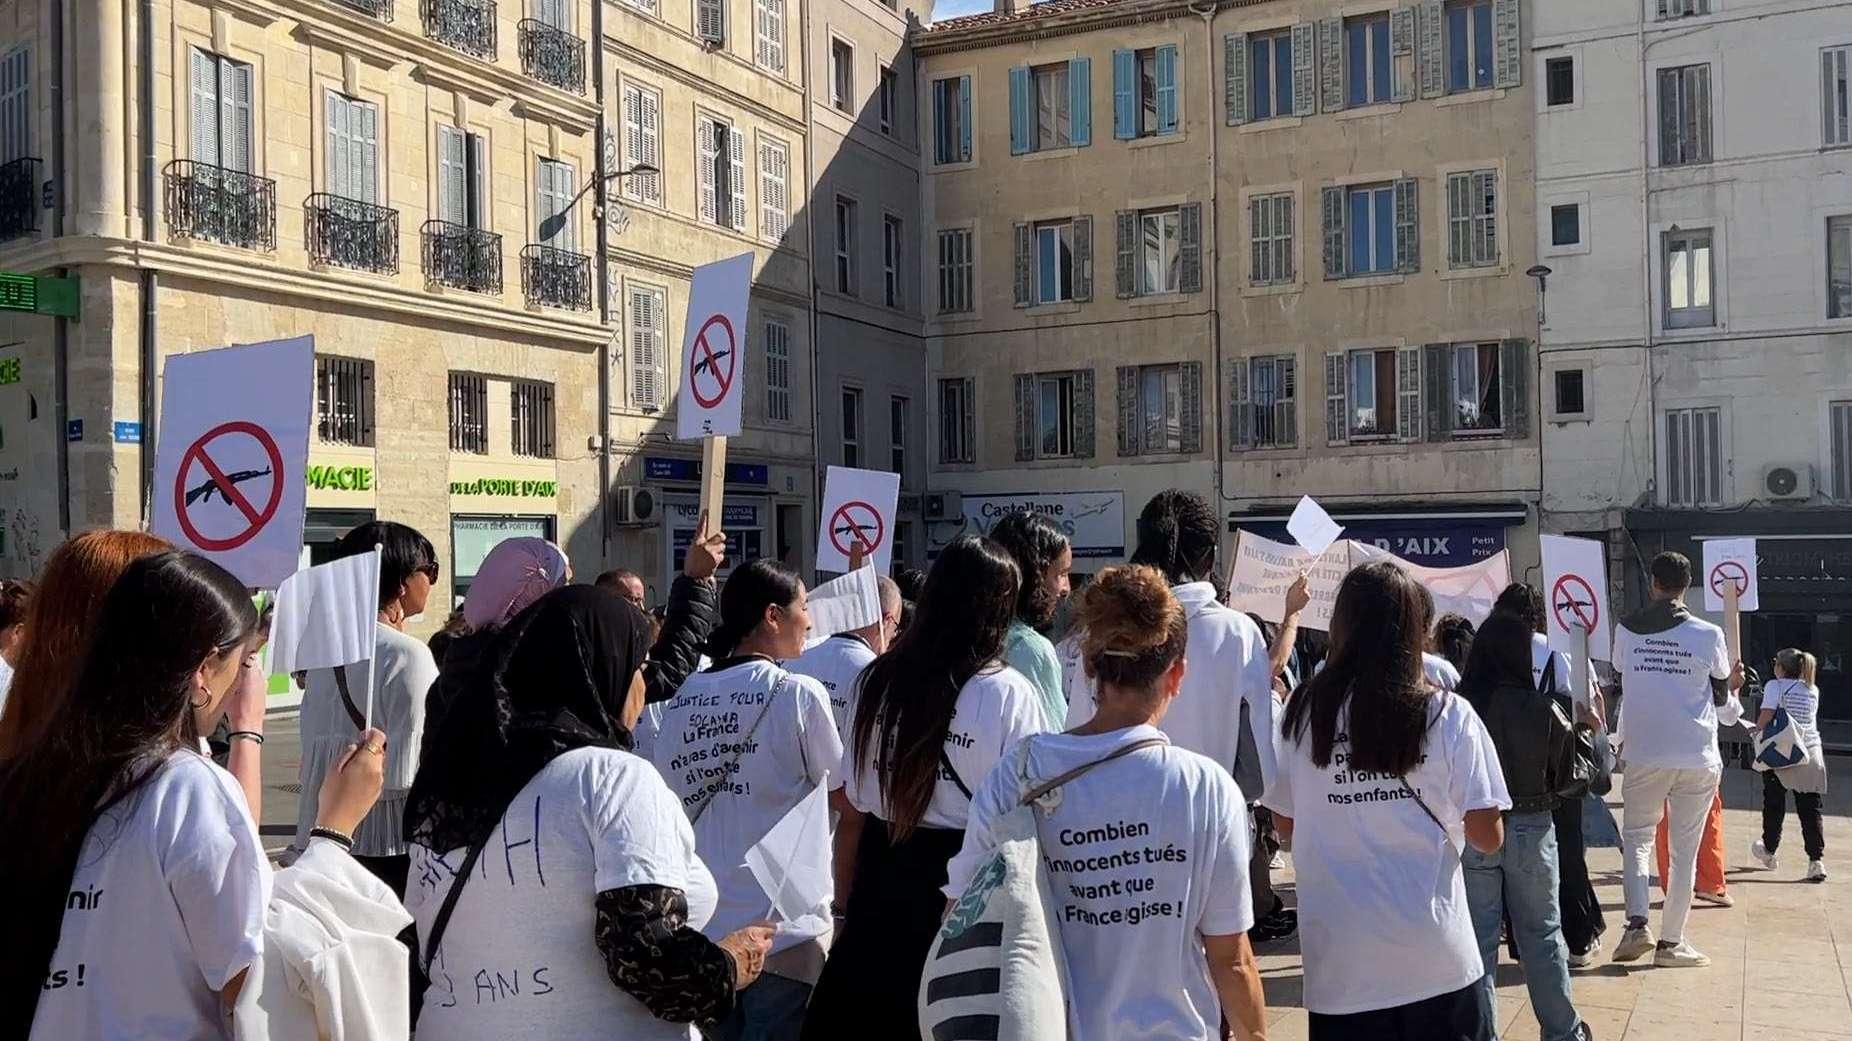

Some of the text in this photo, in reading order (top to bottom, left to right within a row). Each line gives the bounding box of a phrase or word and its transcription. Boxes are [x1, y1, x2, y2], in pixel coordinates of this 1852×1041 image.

[304, 465, 373, 491] MACIE
[478, 479, 521, 496] PORTE
[696, 722, 740, 740] France
[1060, 820, 1150, 847] Combien
[1143, 843, 1188, 863] tués
[67, 883, 104, 910] nir
[1069, 877, 1155, 899] avant que
[1065, 904, 1123, 927] France
[1177, 900, 1183, 918] !
[474, 967, 553, 1004] ANS
